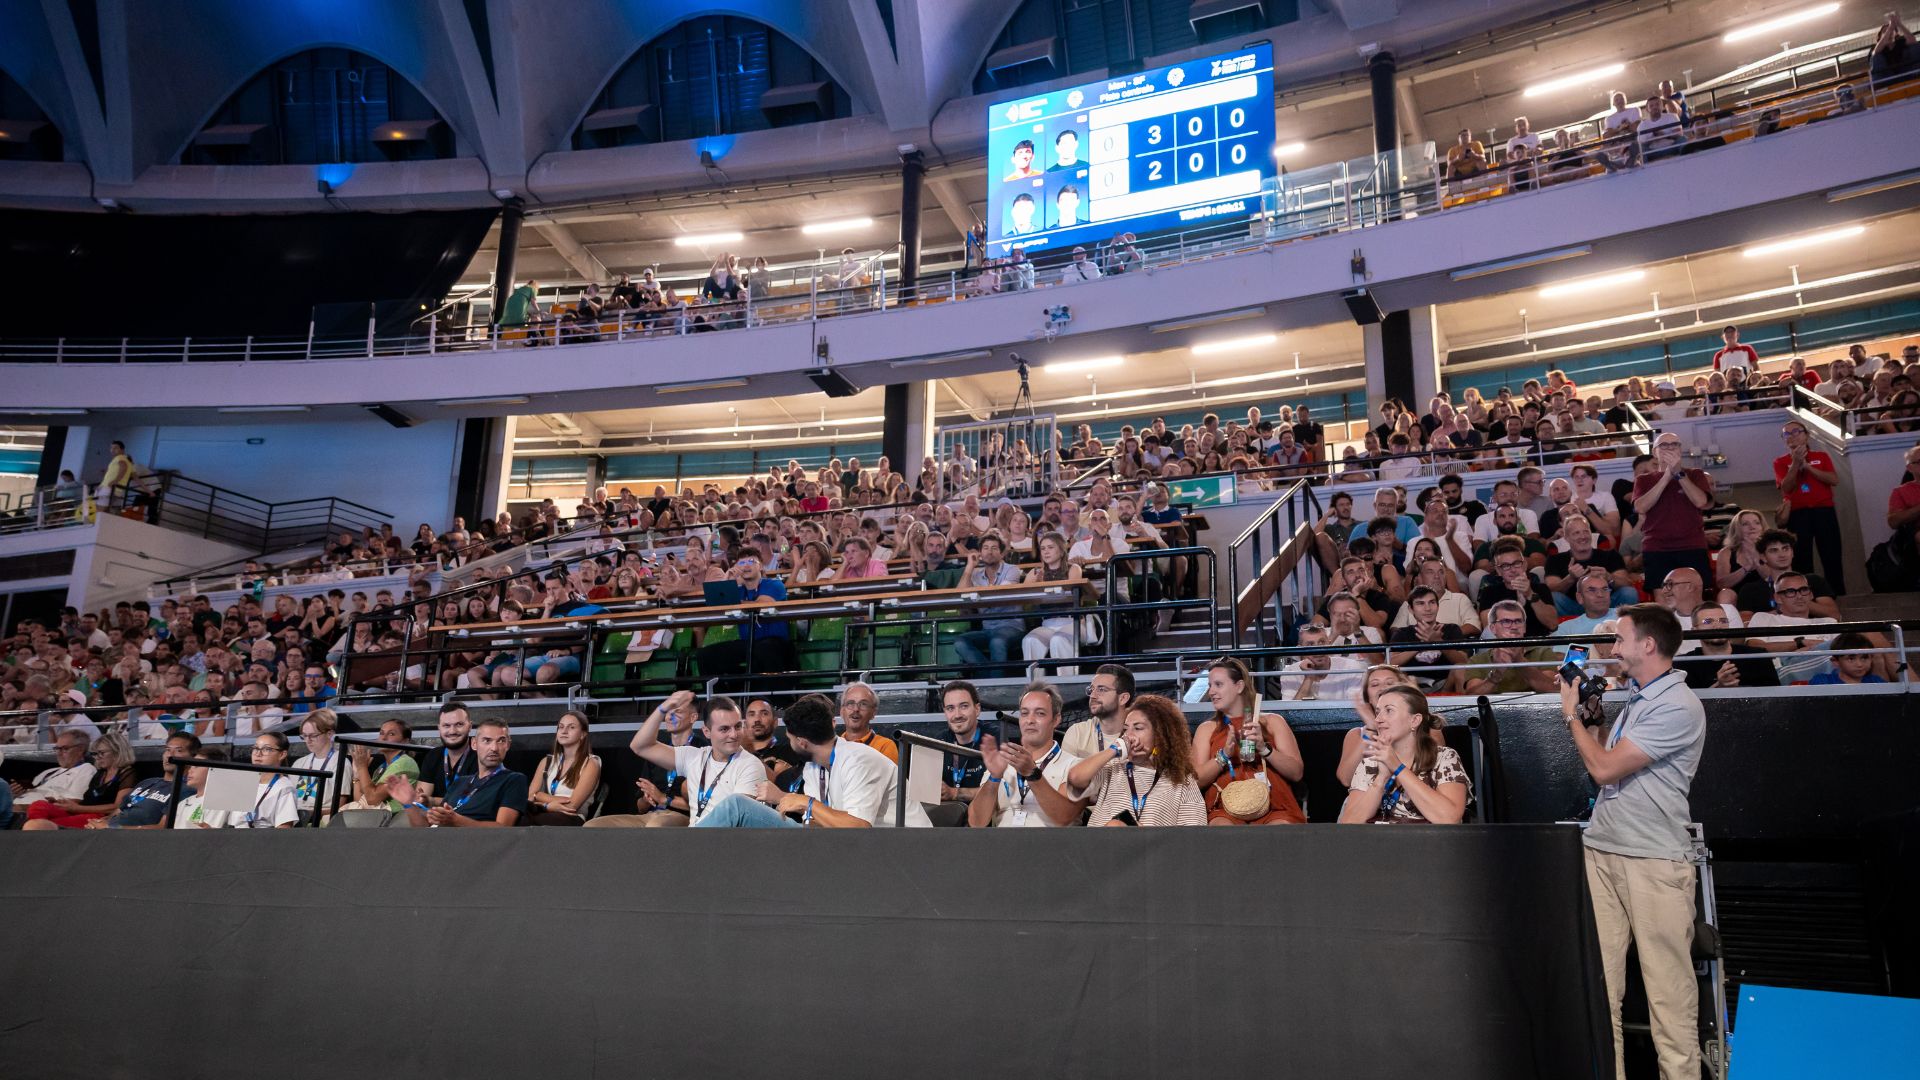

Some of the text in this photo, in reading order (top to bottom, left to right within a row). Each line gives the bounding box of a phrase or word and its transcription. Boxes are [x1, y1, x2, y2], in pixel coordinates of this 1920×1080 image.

[1147, 125, 1162, 145] 3
[1188, 116, 1203, 137] 0
[1230, 107, 1245, 128] 0
[1148, 160, 1163, 181] 2
[1189, 152, 1204, 173] 0
[1231, 144, 1246, 165] 0
